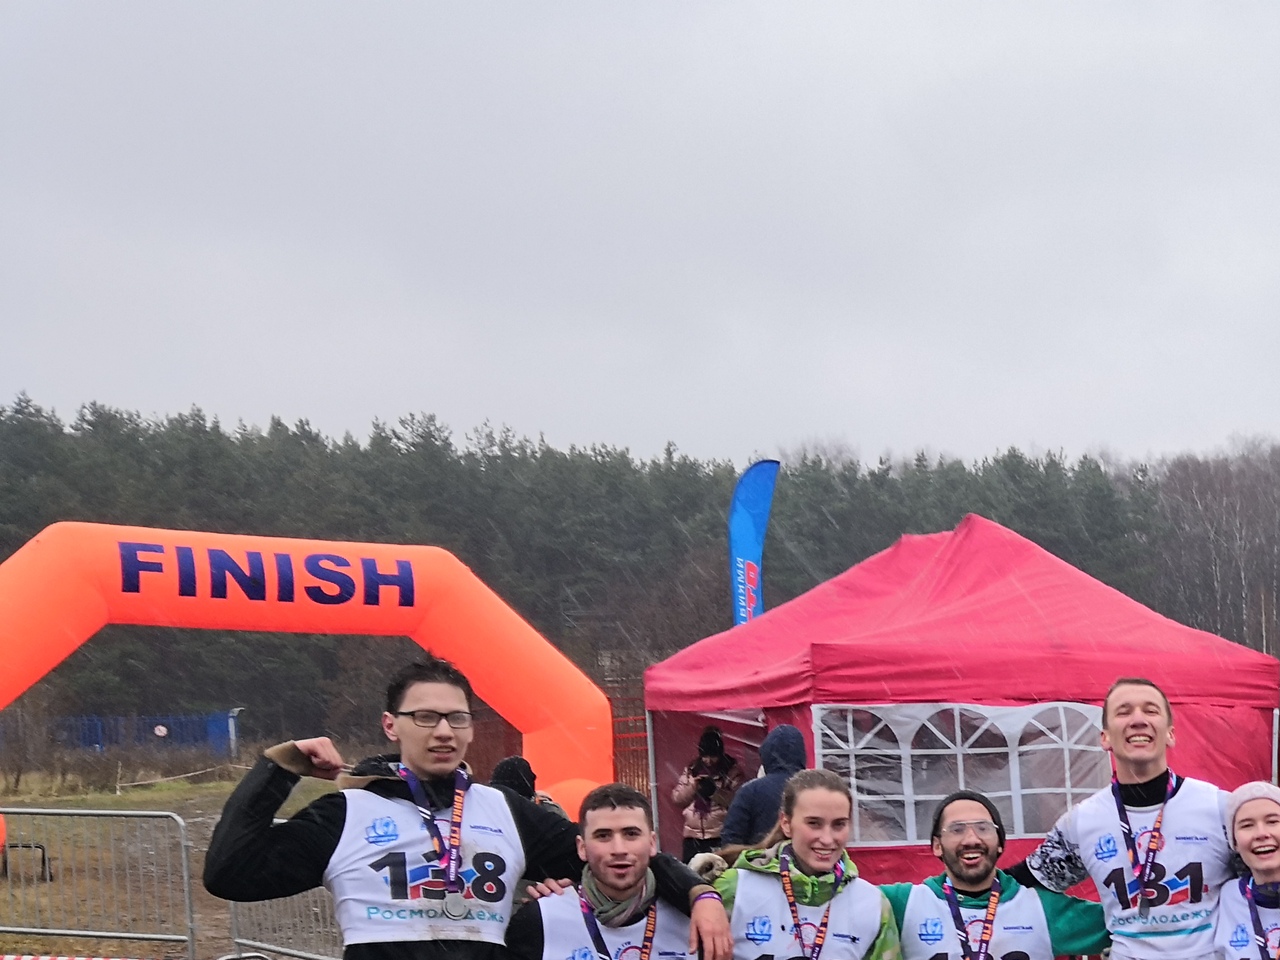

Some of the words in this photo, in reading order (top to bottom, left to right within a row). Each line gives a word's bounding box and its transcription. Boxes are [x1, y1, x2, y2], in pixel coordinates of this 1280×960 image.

[118, 541, 415, 607] FINISH
[450, 826, 462, 846] ГТО
[368, 850, 507, 903] 138
[1103, 862, 1203, 910] 131
[366, 906, 505, 923] Росмодежь
[981, 923, 992, 941] ГТО
